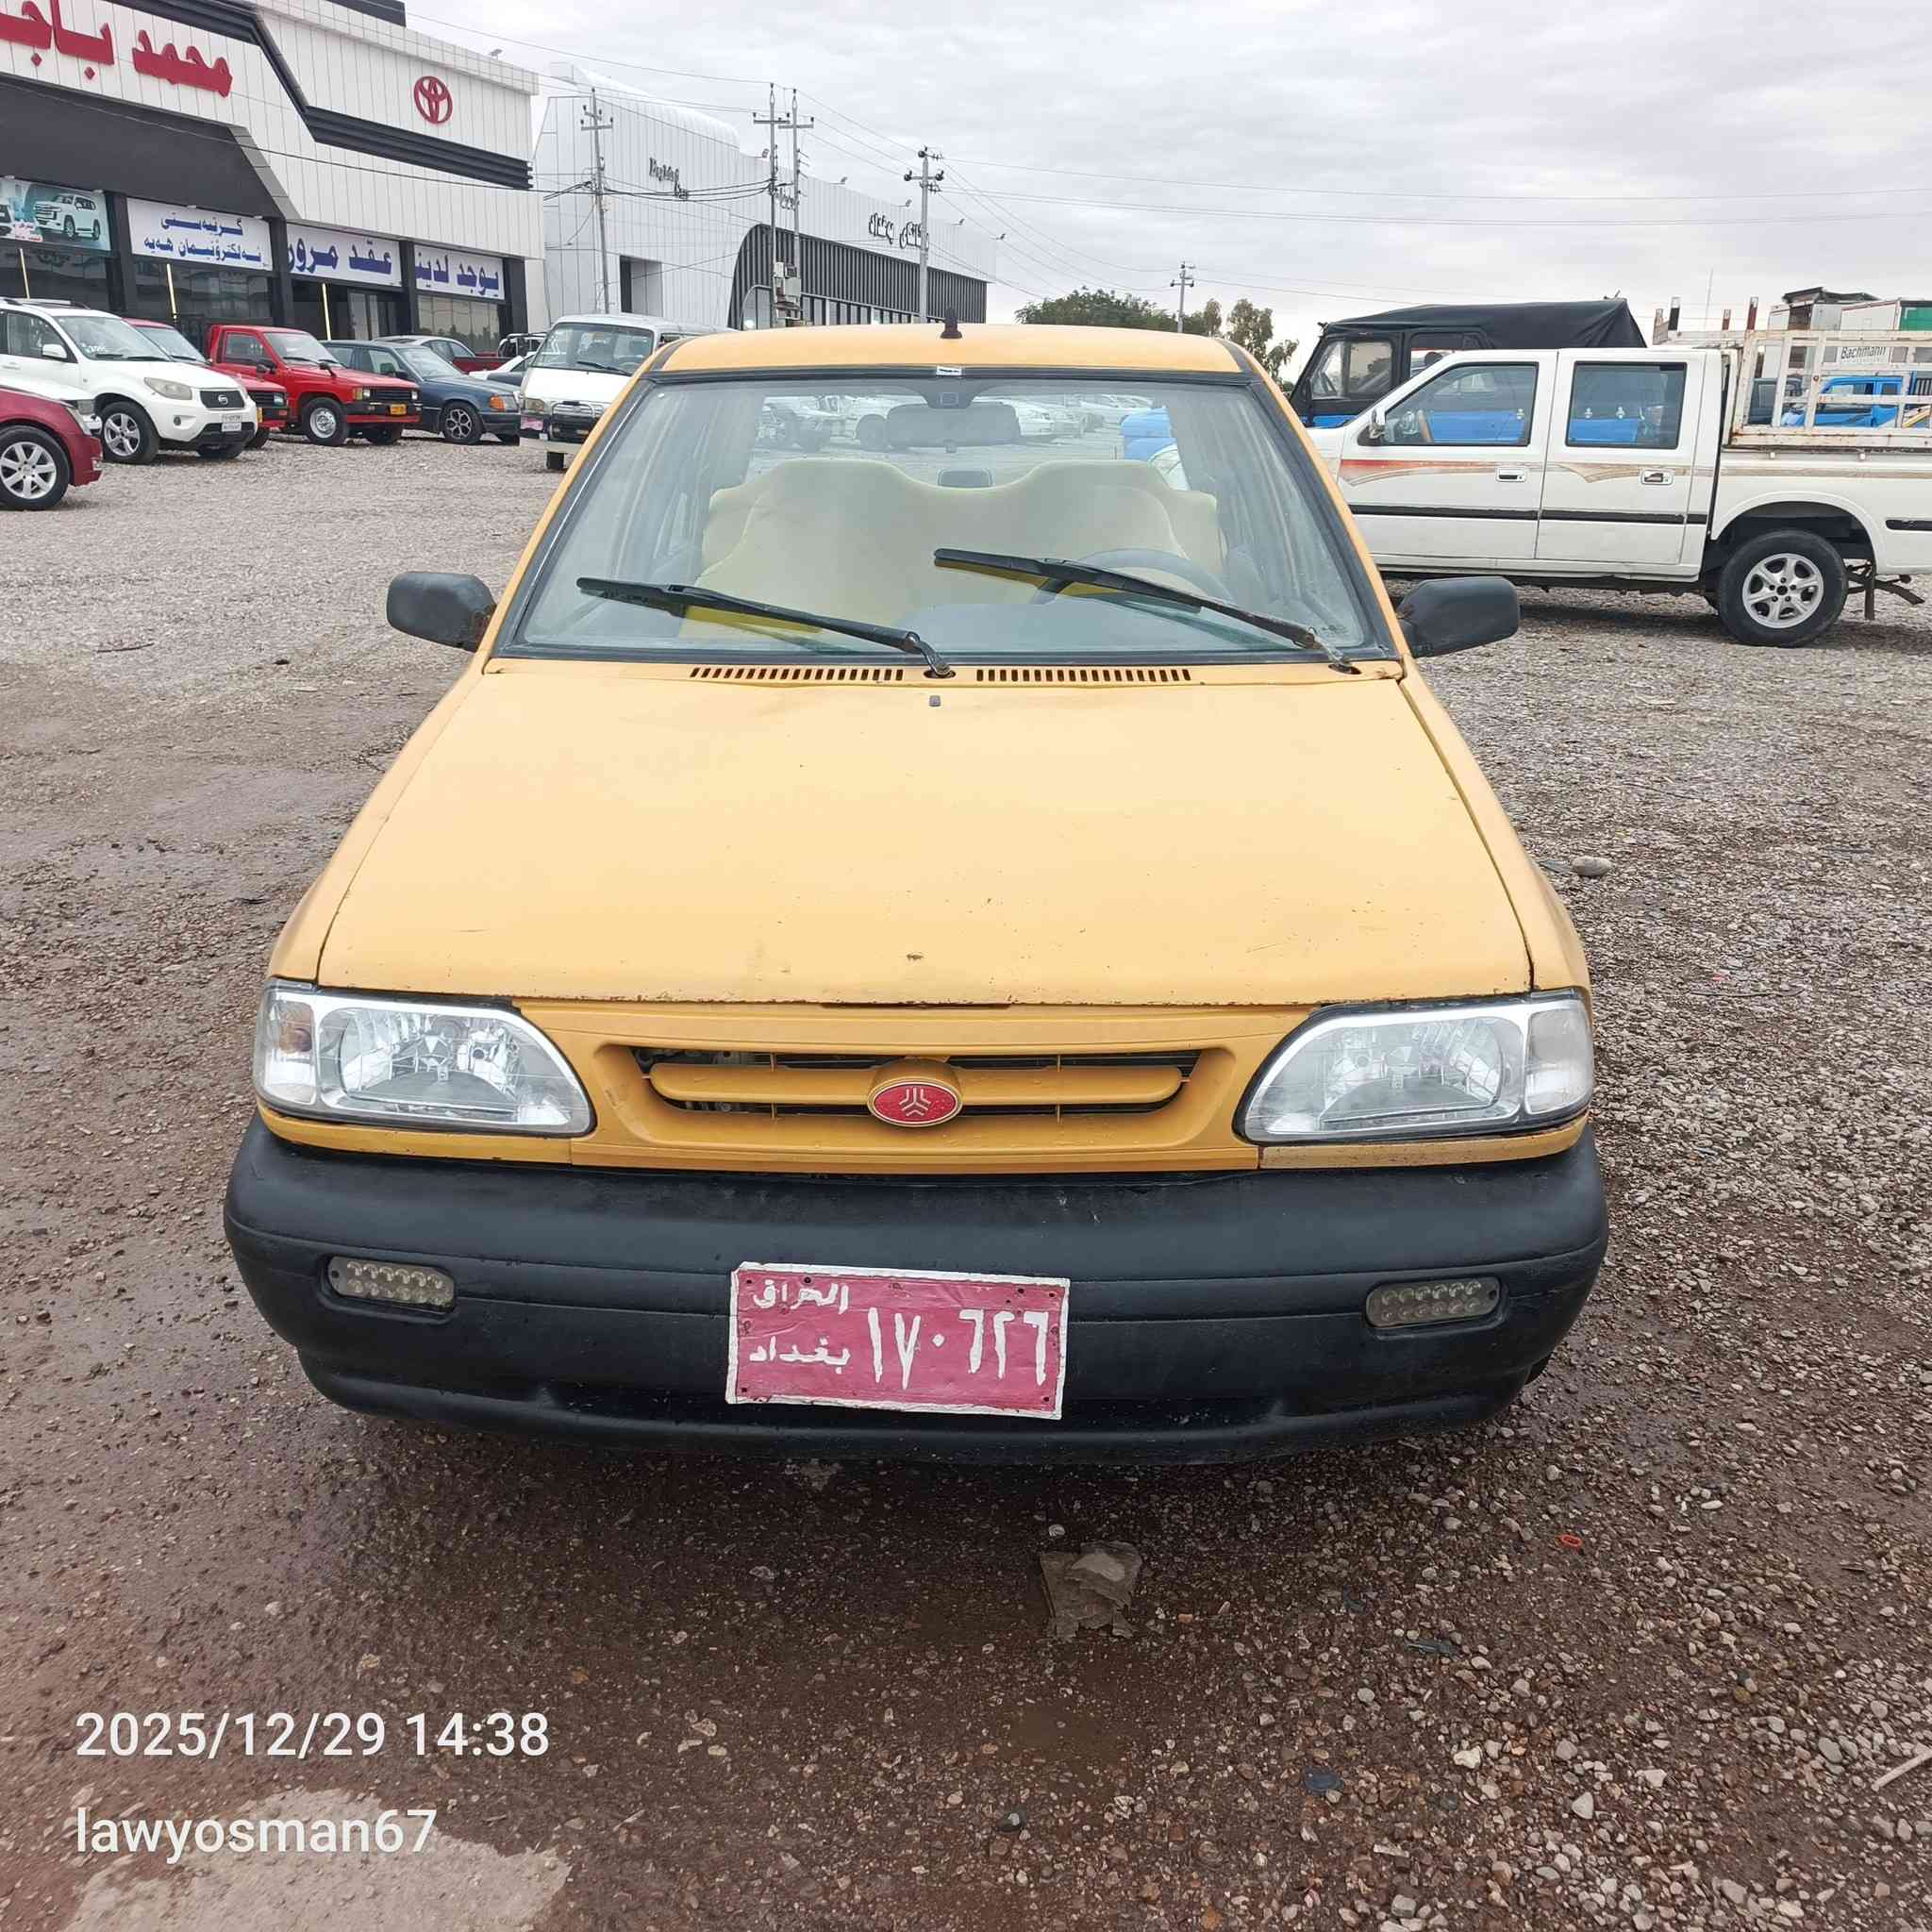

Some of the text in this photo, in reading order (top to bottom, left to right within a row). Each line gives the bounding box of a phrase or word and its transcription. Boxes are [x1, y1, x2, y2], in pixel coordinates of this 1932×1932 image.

[0, 0, 233, 98] محمد باج
[288, 238, 392, 275] عقد مرور
[415, 252, 499, 297] يوجد لدين
[1840, 346, 1887, 359] Bachmann
[754, 1279, 849, 1314] العراق
[750, 1336, 851, 1374] بغداد
[867, 1307, 1049, 1391] ١٧٠٦٢٦
